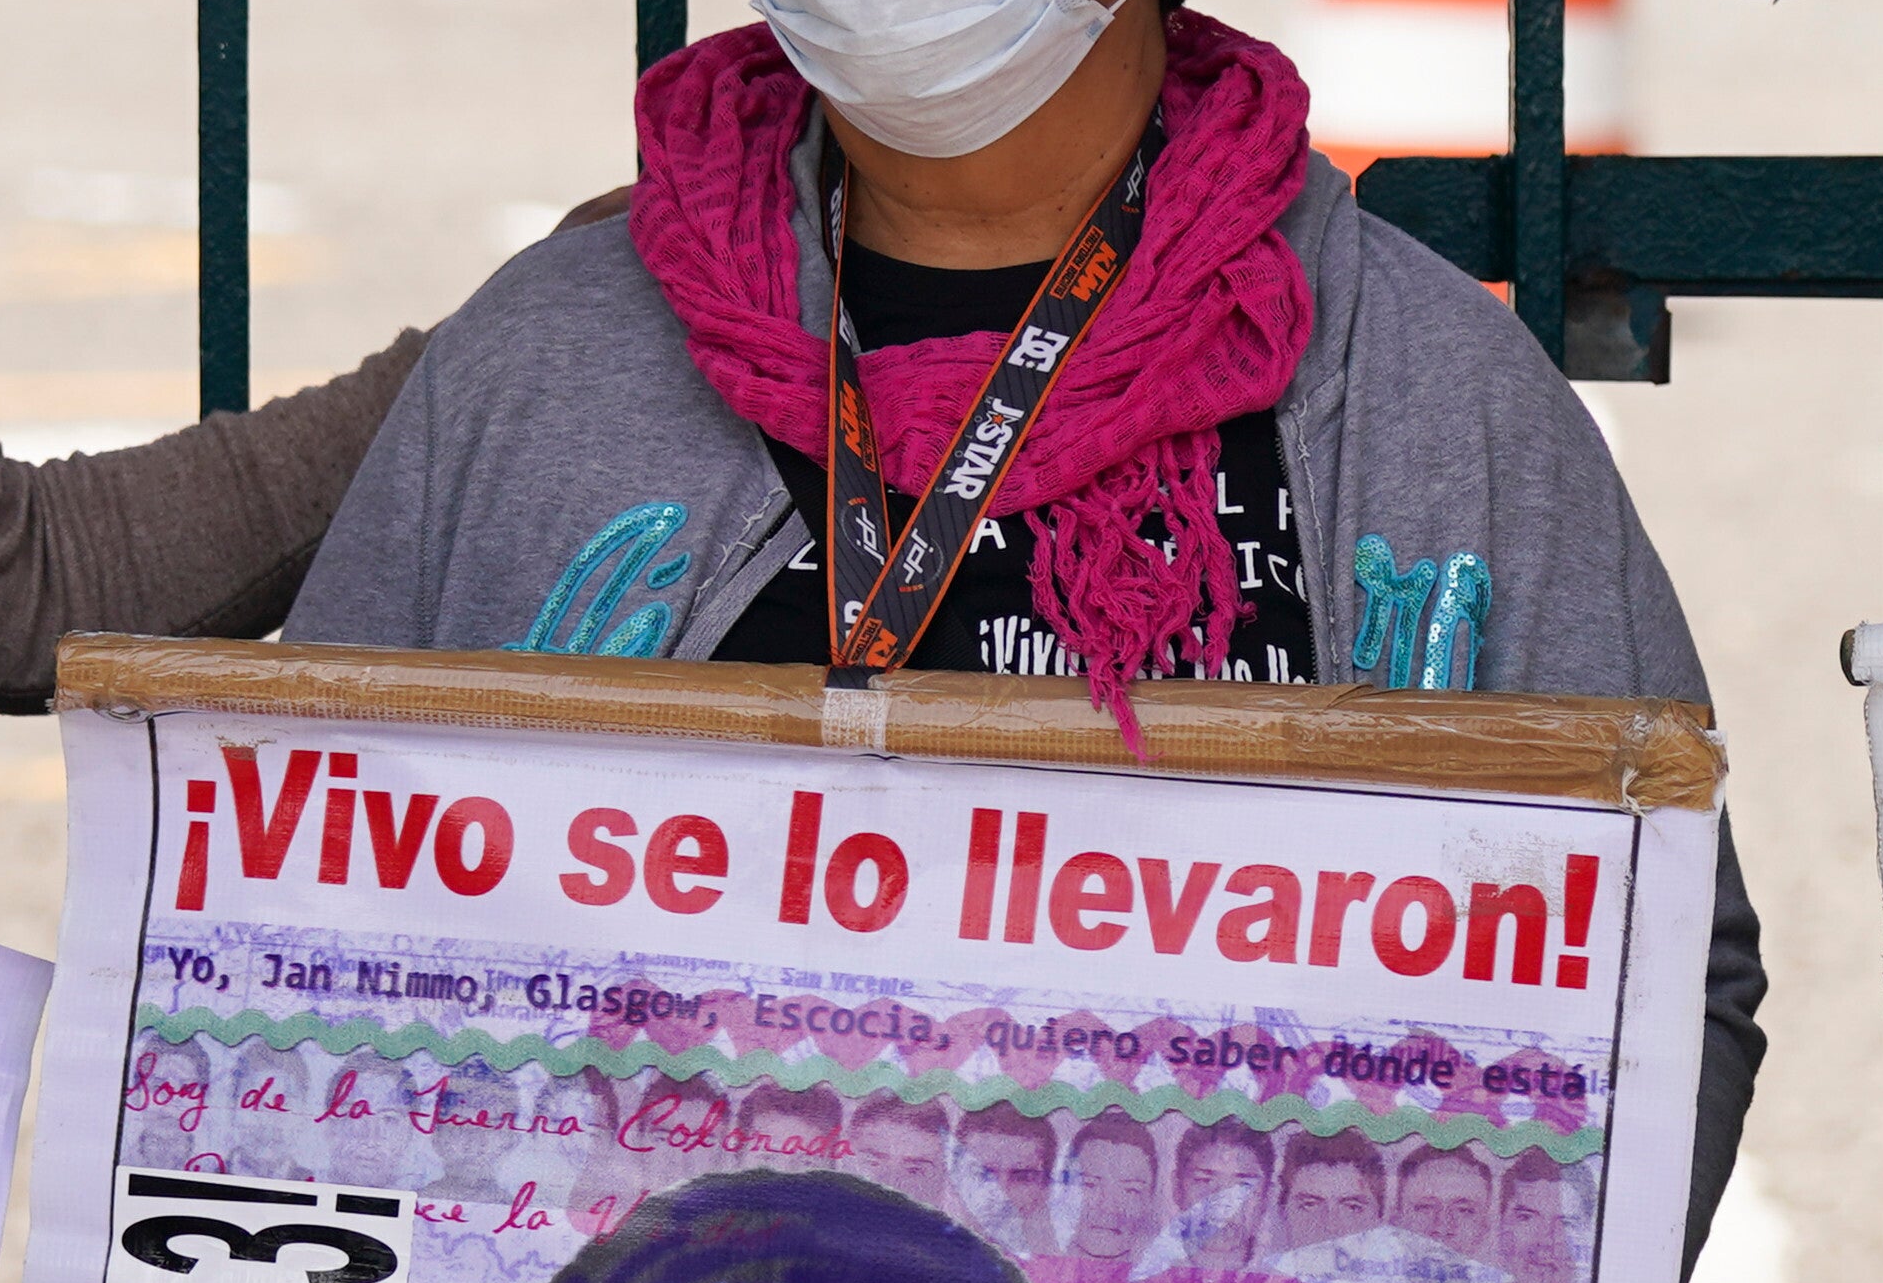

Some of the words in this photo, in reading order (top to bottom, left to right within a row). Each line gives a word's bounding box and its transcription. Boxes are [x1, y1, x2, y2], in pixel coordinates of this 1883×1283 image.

[1071, 241, 1118, 302] KTM
[175, 747, 515, 911] ¡Vivo
[558, 806, 730, 914] se
[778, 790, 909, 933] lo
[958, 807, 1600, 991] llevaron!
[168, 947, 230, 992] Yo,
[262, 954, 332, 992] Jan
[357, 960, 496, 1013] Nimmo,
[526, 974, 719, 1029] Glasgow,
[754, 993, 952, 1051] Escocia,
[985, 1015, 1140, 1065] quiero
[1167, 1025, 1299, 1075] saber
[1324, 1043, 1455, 1090] dónde
[1482, 1062, 1587, 1101] está
[124, 1052, 209, 1132] Soy
[240, 1077, 290, 1112] de
[314, 1070, 375, 1123] la
[409, 1075, 584, 1137] Tierra
[617, 1093, 856, 1161] Colorada
[494, 1180, 553, 1234] la
